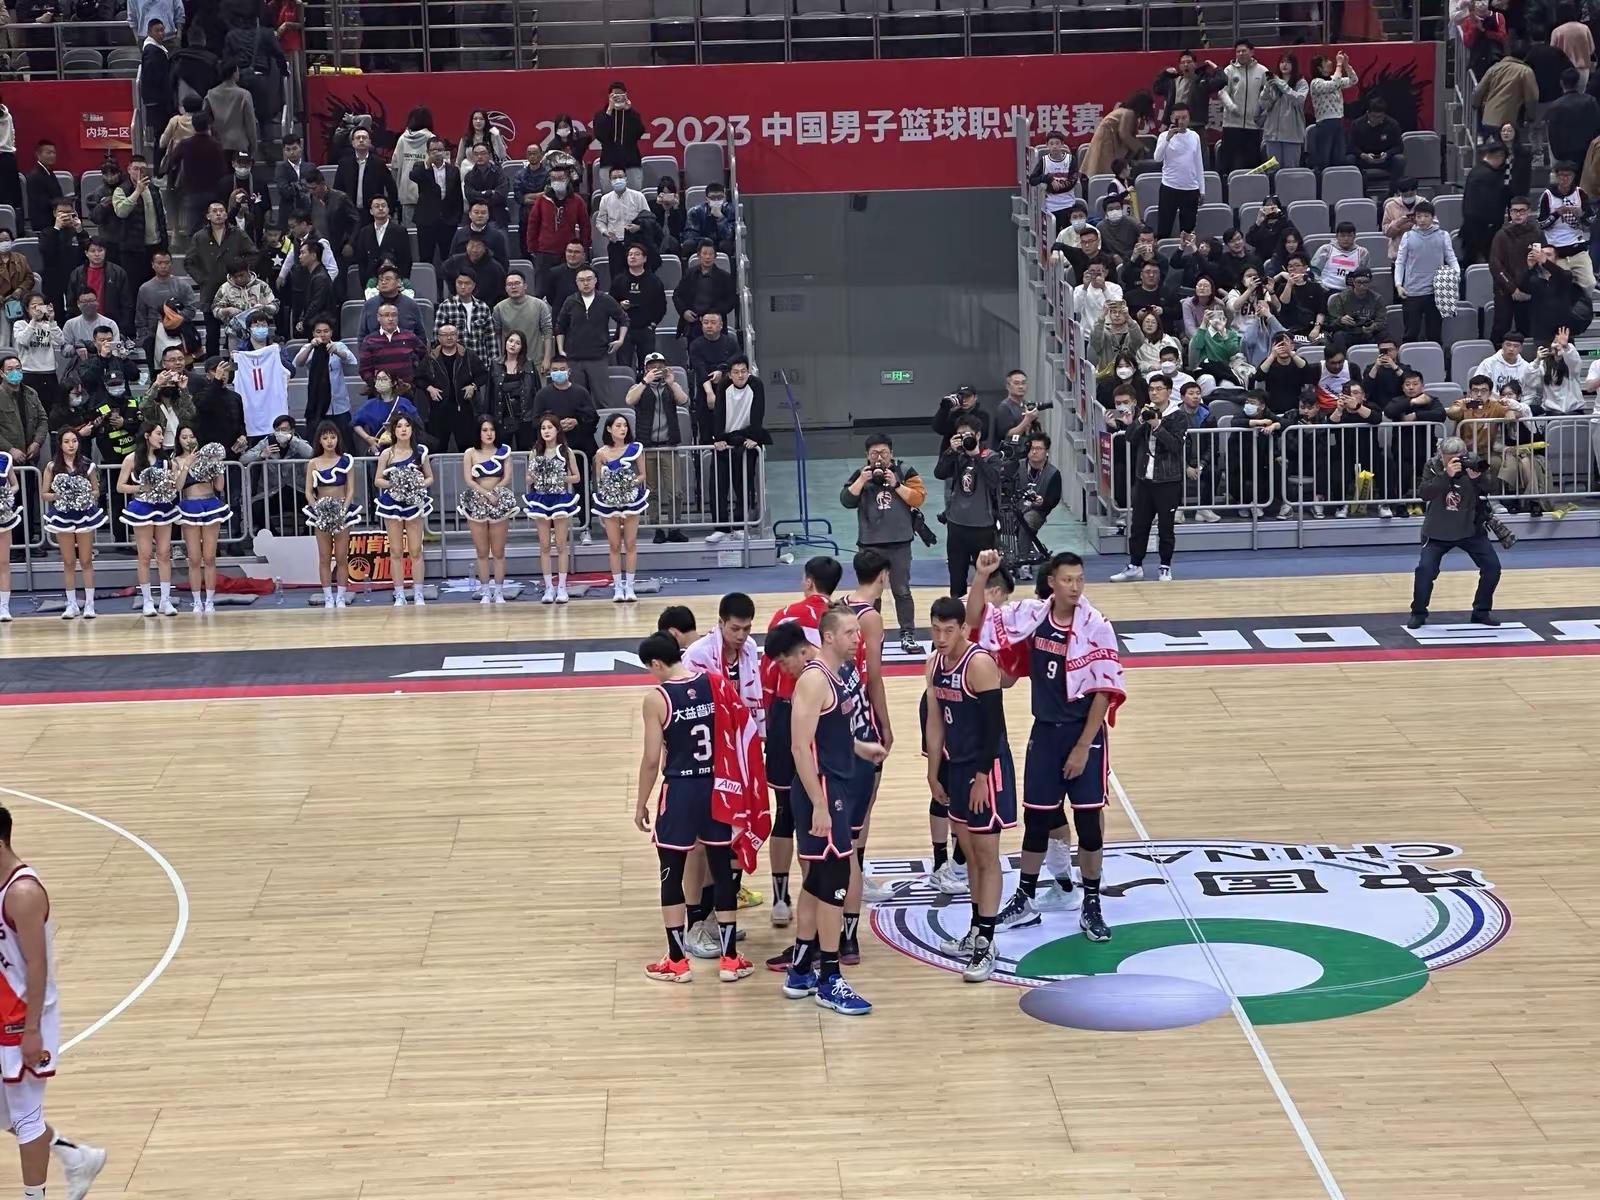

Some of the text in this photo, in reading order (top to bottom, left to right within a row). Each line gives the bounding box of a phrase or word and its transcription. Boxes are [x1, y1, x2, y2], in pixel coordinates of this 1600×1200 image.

[86, 127, 130, 138] 内场二区
[761, 102, 1104, 146] 中国男子篮球职业联赛
[252, 367, 264, 391] 11
[1046, 660, 1058, 679] 9
[690, 724, 713, 762] 3
